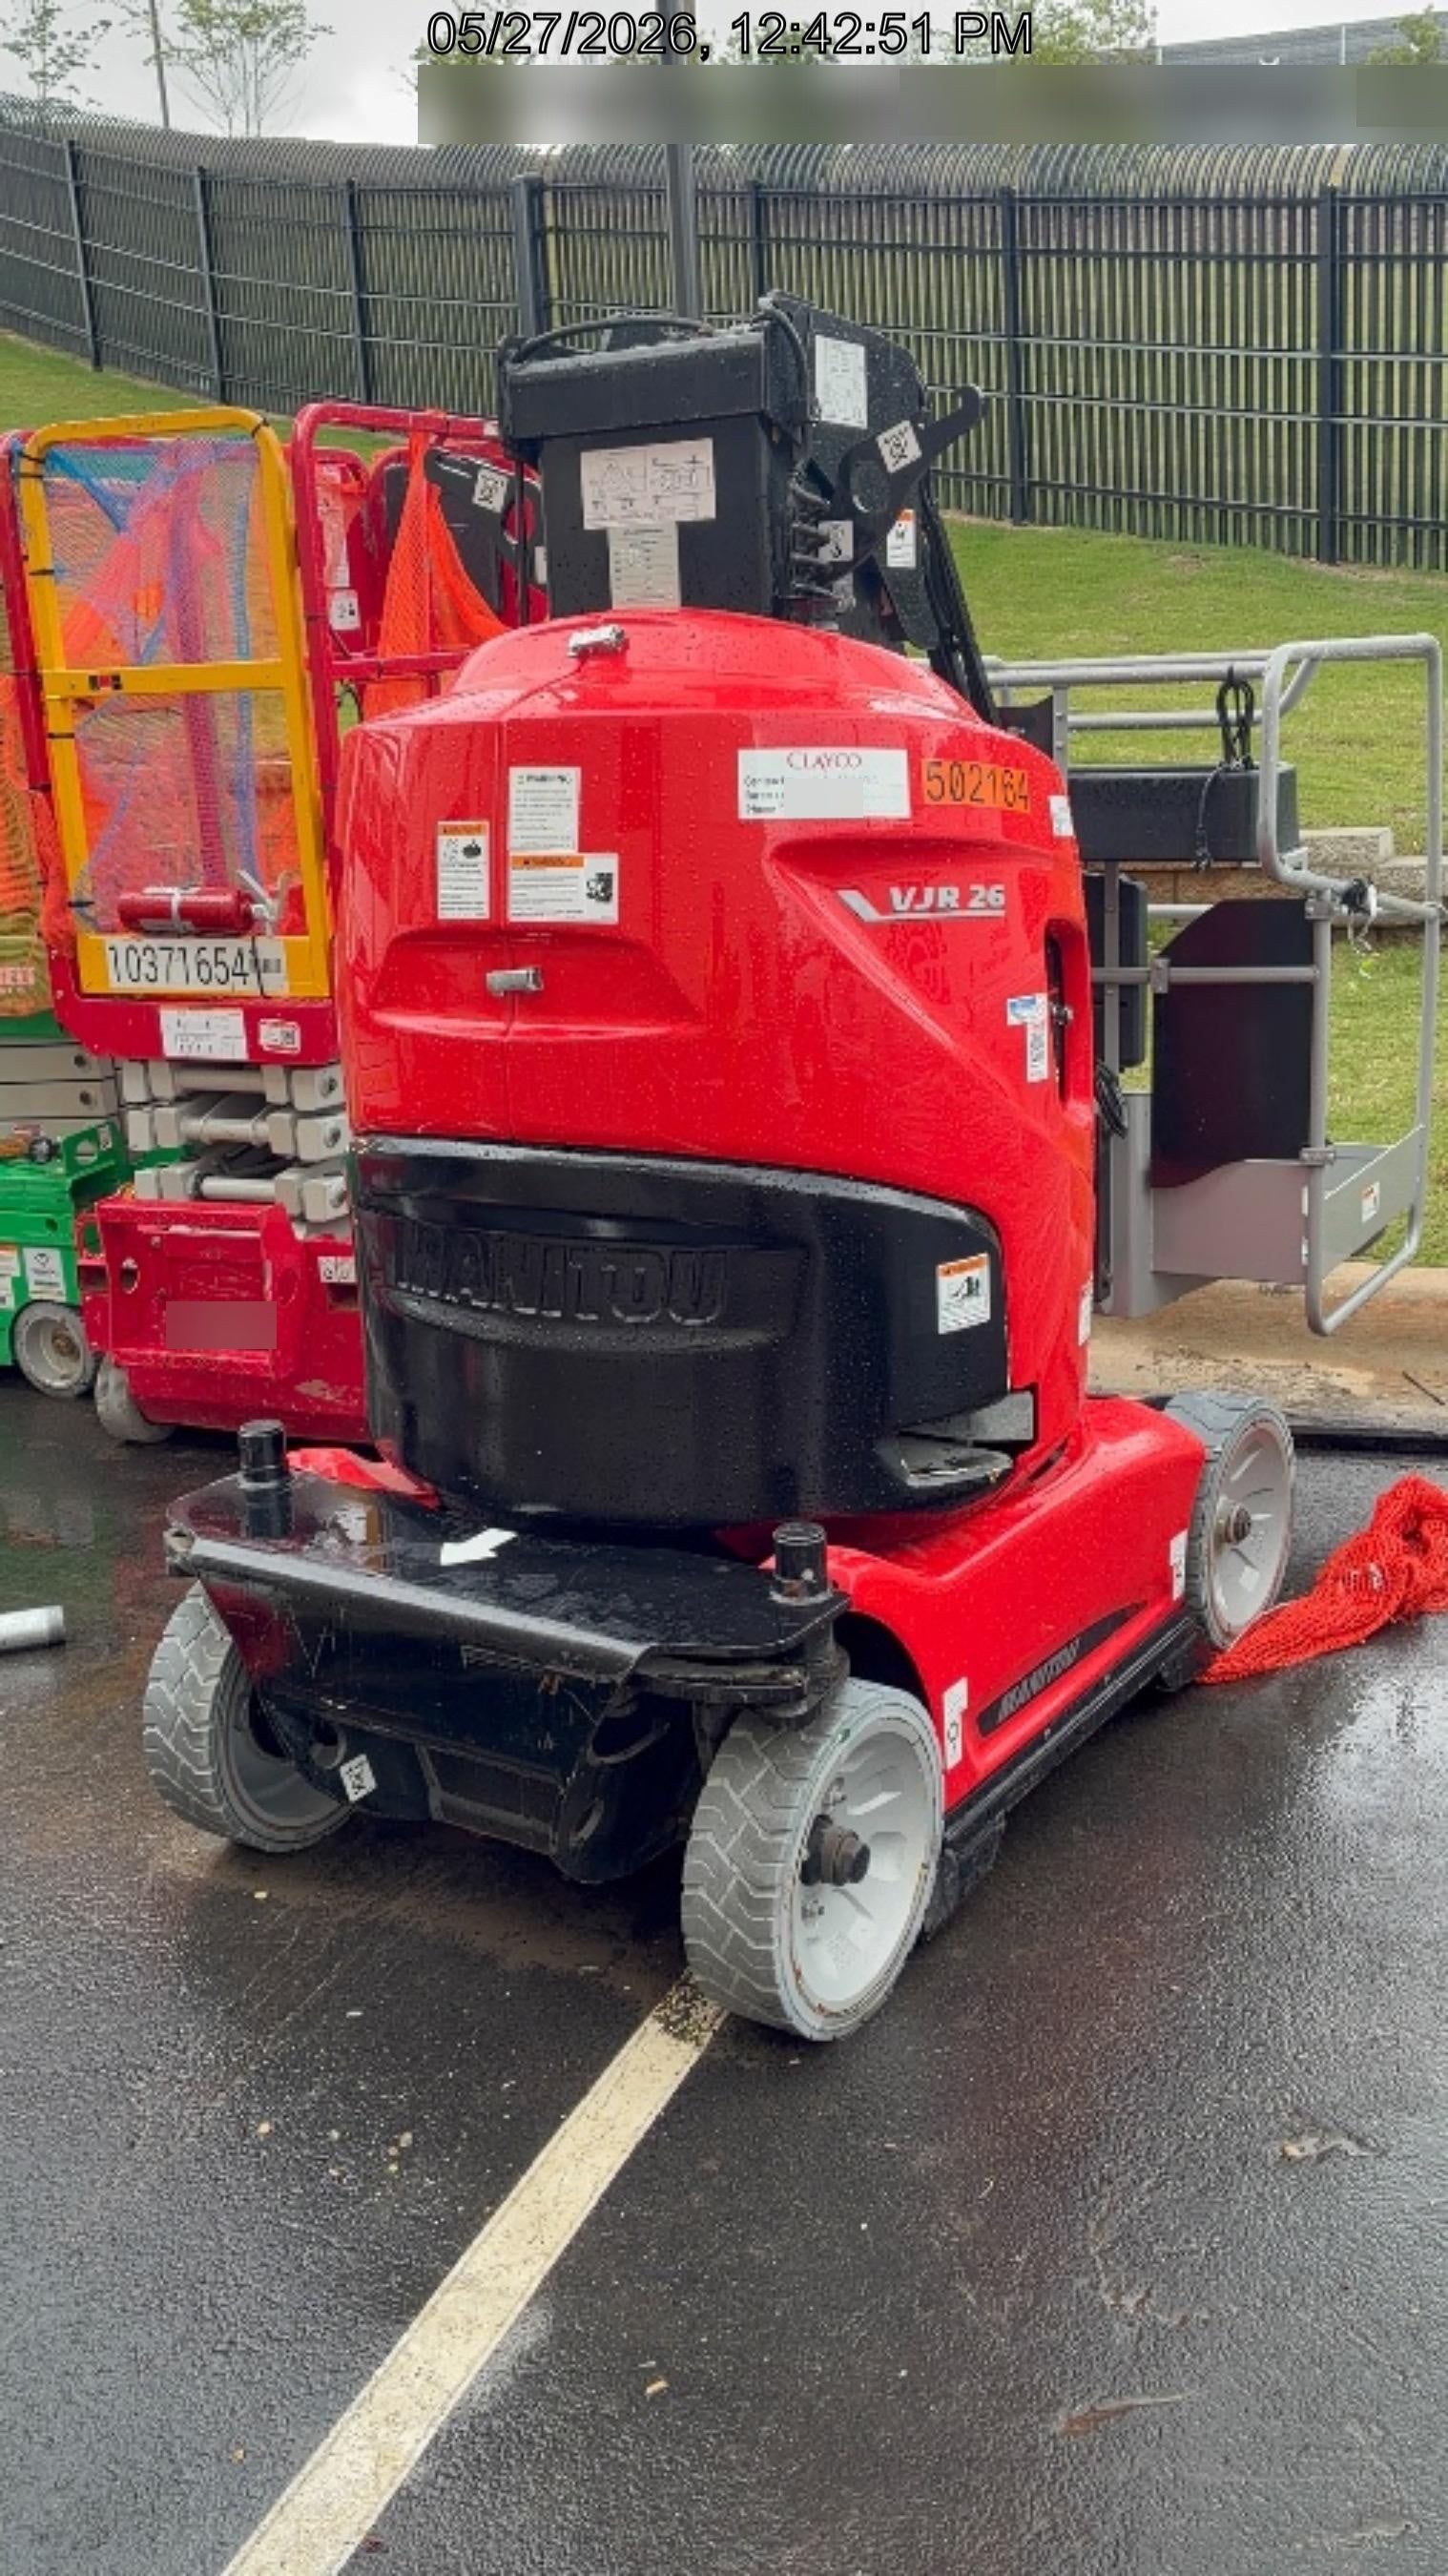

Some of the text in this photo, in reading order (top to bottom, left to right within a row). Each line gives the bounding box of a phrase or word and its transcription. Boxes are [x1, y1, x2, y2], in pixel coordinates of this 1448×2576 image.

[925, 760, 1028, 811] 502164
[889, 883, 1005, 911] VJR 26
[109, 945, 250, 987] 10371654
